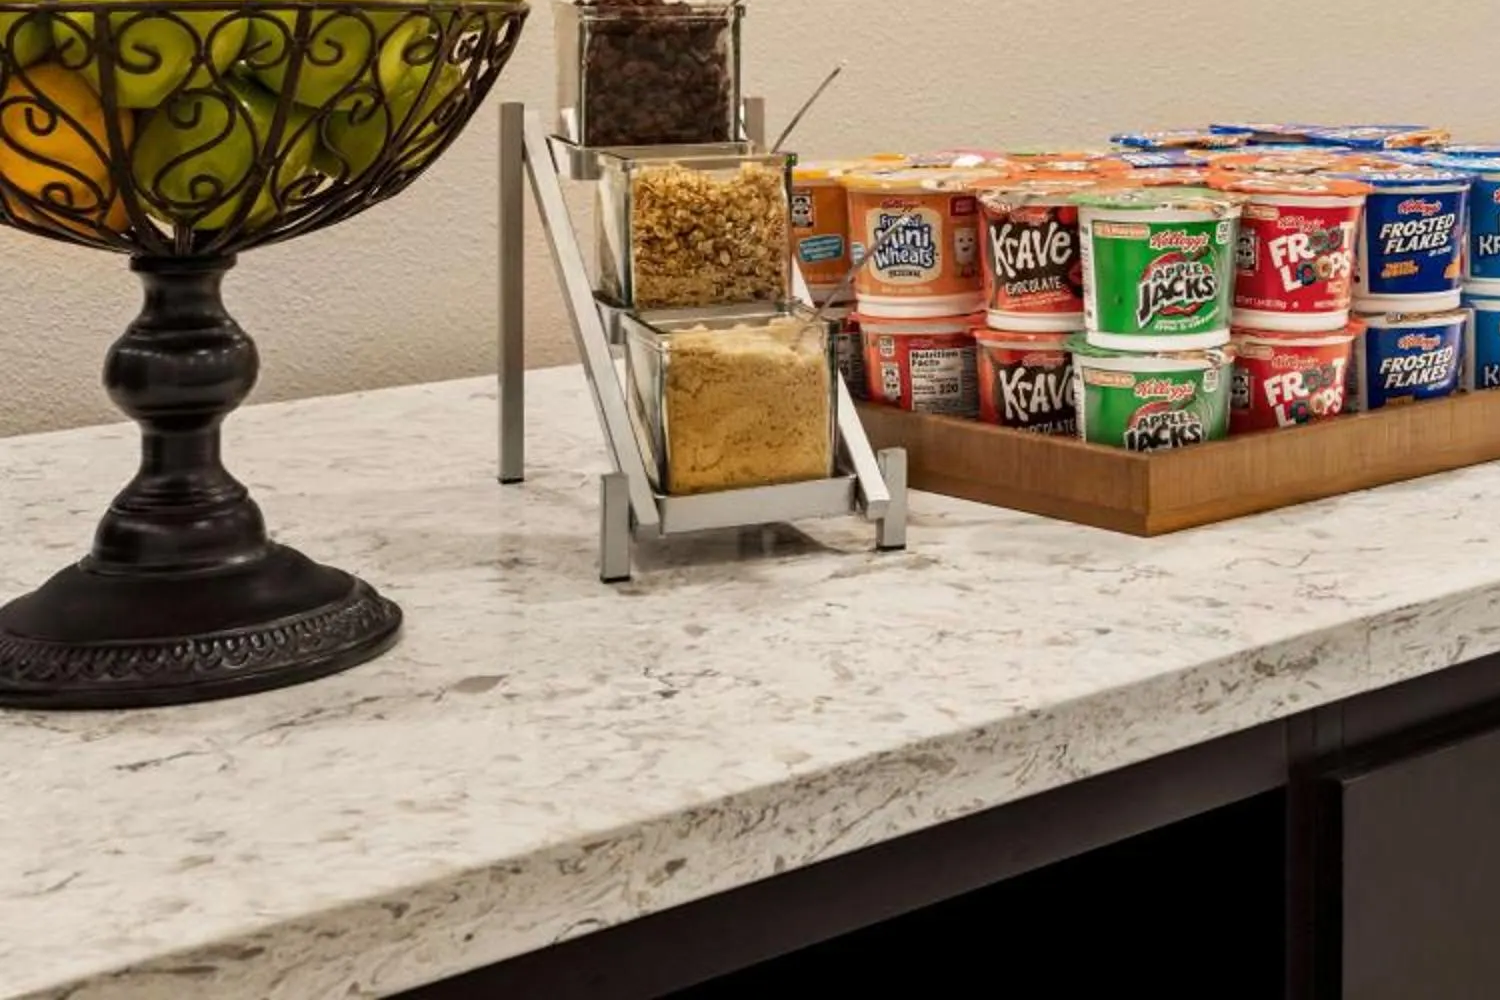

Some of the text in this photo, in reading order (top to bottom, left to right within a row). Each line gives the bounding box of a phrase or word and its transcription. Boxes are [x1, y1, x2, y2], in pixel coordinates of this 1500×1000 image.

[875, 226, 931, 250] Mini
[1379, 213, 1455, 240] FROSTED
[1268, 221, 1355, 269] FROOT
[1384, 230, 1449, 255] FLAKES
[875, 246, 934, 269] Wheats
[1280, 249, 1352, 293] LOOPS
[1005, 275, 1063, 295] CHOCOLATE
[1152, 262, 1203, 282] APPLE
[1138, 275, 1217, 325] JACKS
[1379, 345, 1453, 374] FROSTED
[1263, 358, 1346, 407] FROOT
[1384, 363, 1448, 389] FLAKES
[1275, 386, 1344, 428] LOOPS
